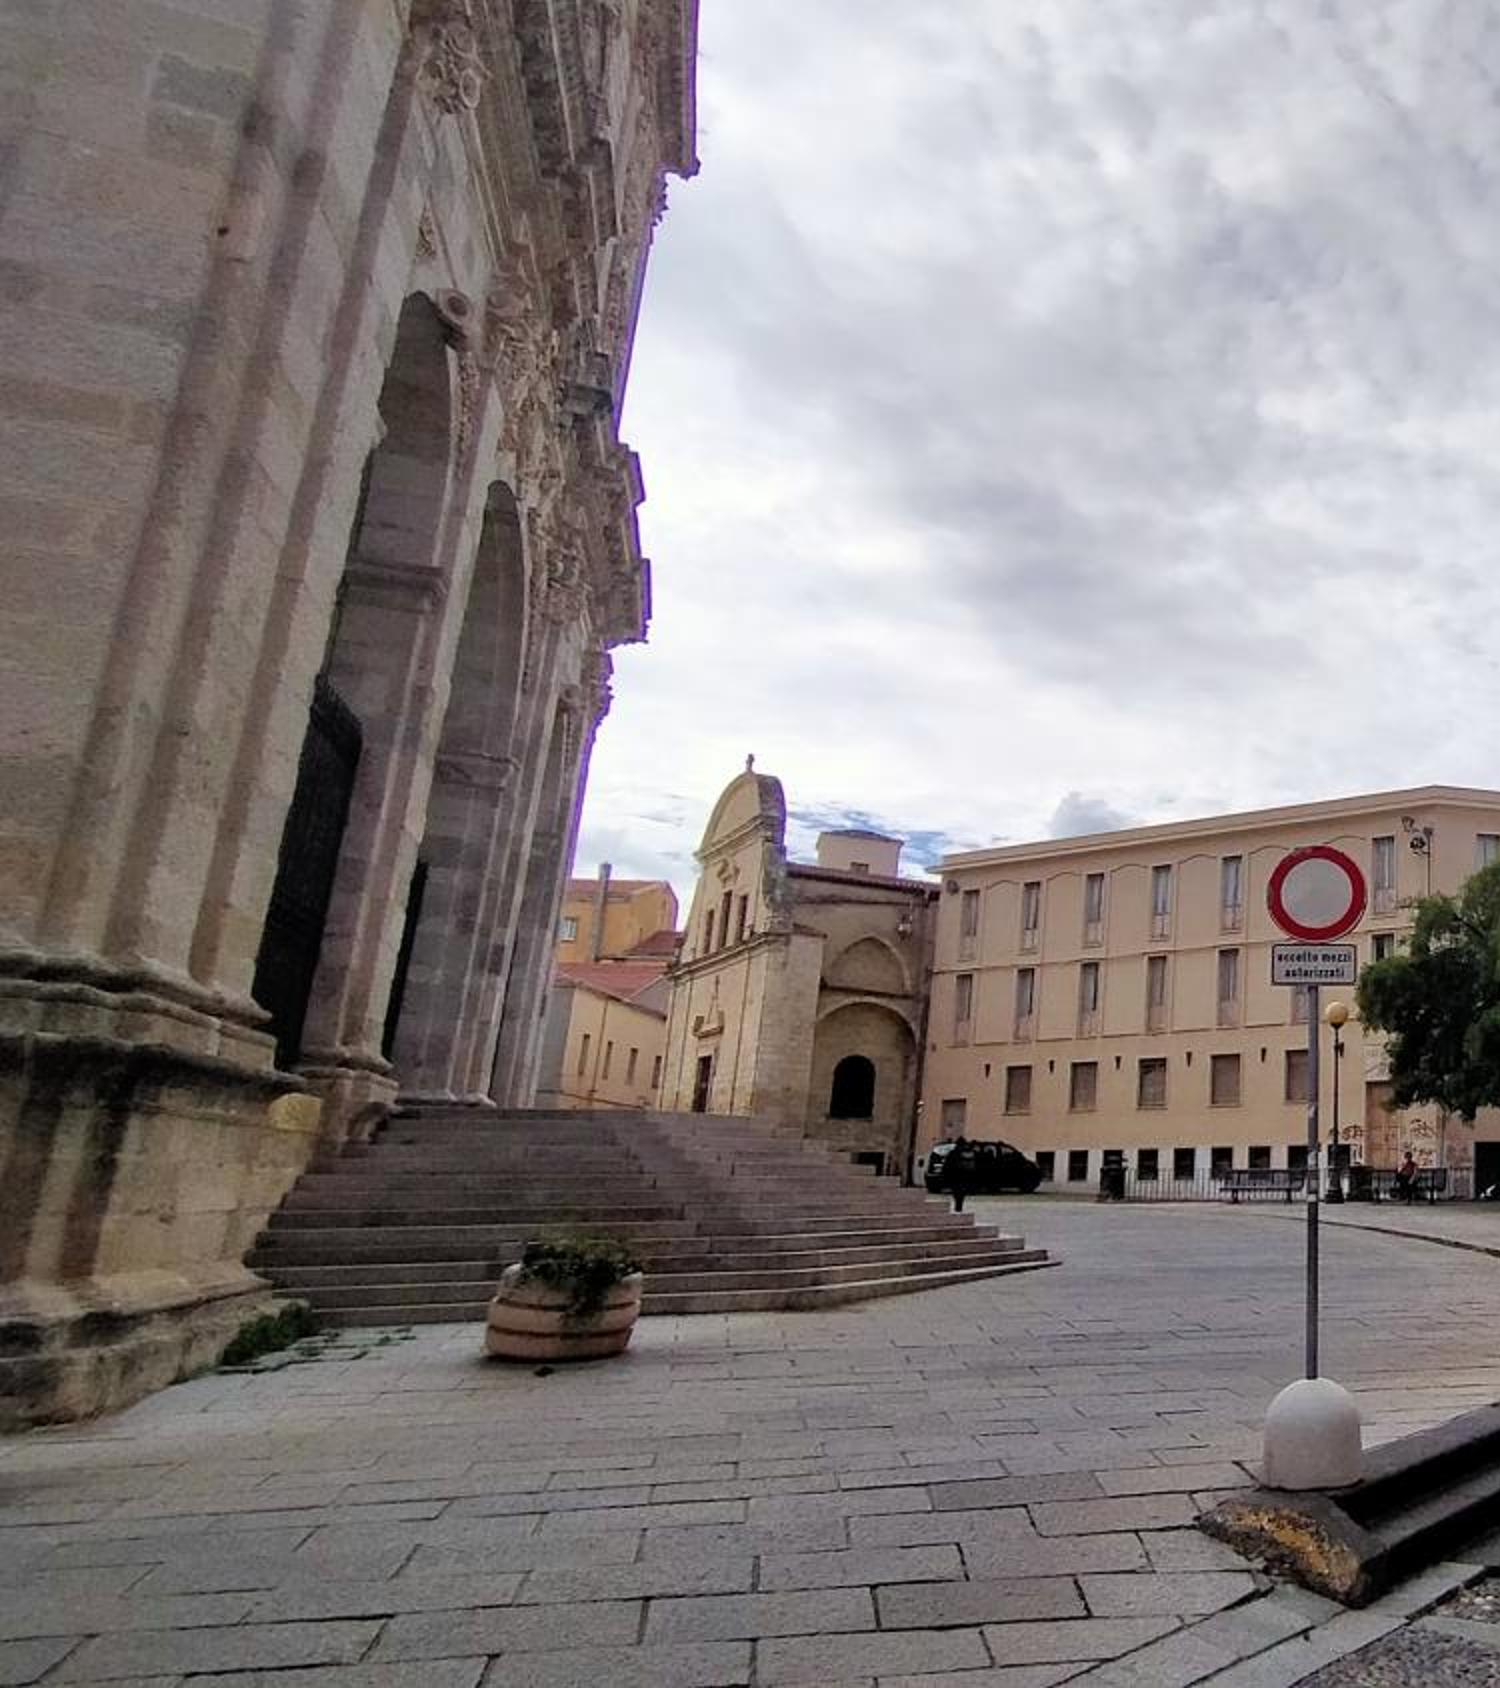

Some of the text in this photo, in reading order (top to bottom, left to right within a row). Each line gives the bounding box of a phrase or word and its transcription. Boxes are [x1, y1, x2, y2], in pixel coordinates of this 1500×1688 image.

[1277, 951, 1352, 962] eccetto mezzi
[1285, 967, 1345, 978] autorizzati
